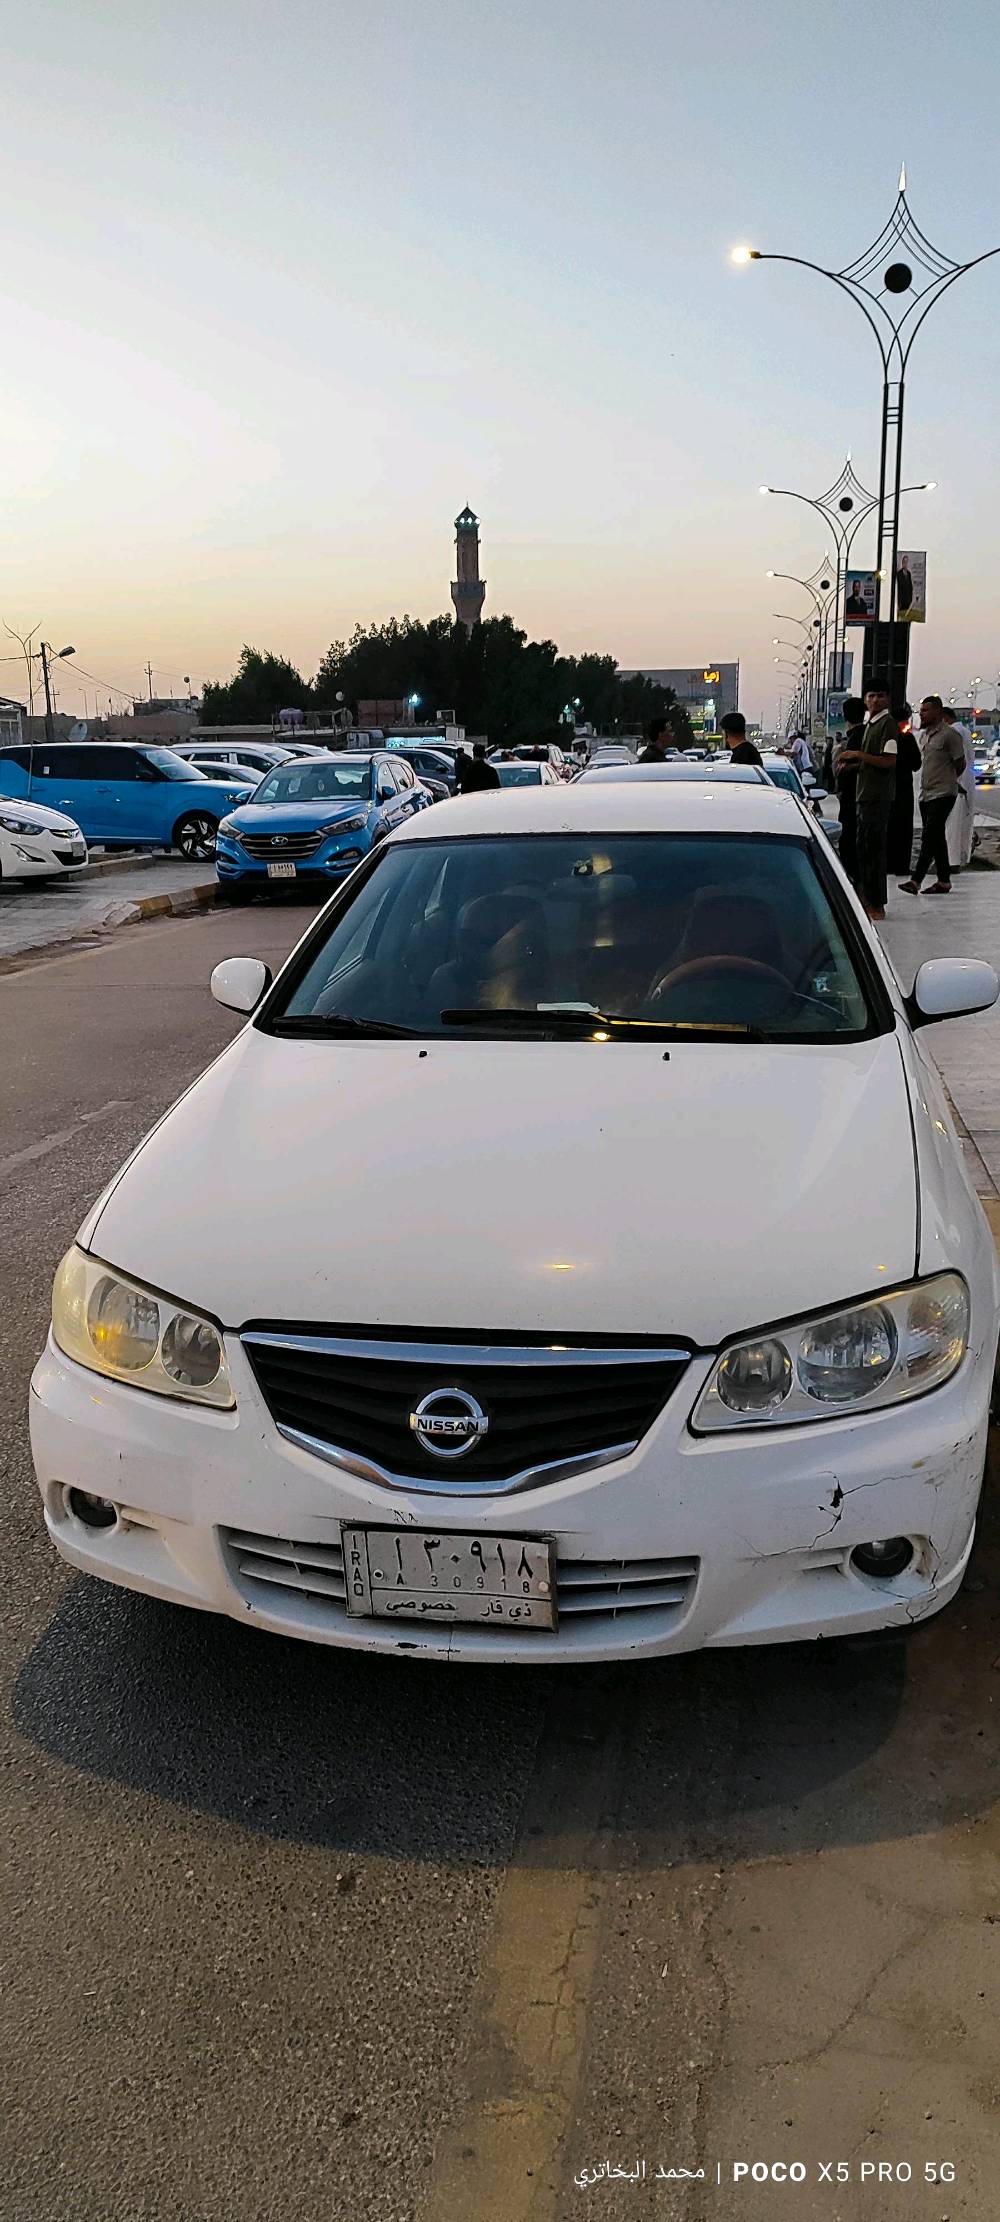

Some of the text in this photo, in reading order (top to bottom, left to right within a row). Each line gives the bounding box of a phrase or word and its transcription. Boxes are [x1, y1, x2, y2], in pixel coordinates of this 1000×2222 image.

[417, 1419, 479, 1432] NISSAN
[351, 1534, 364, 1597] IRAQ
[385, 1599, 532, 1618] ذي قار خصوصي
